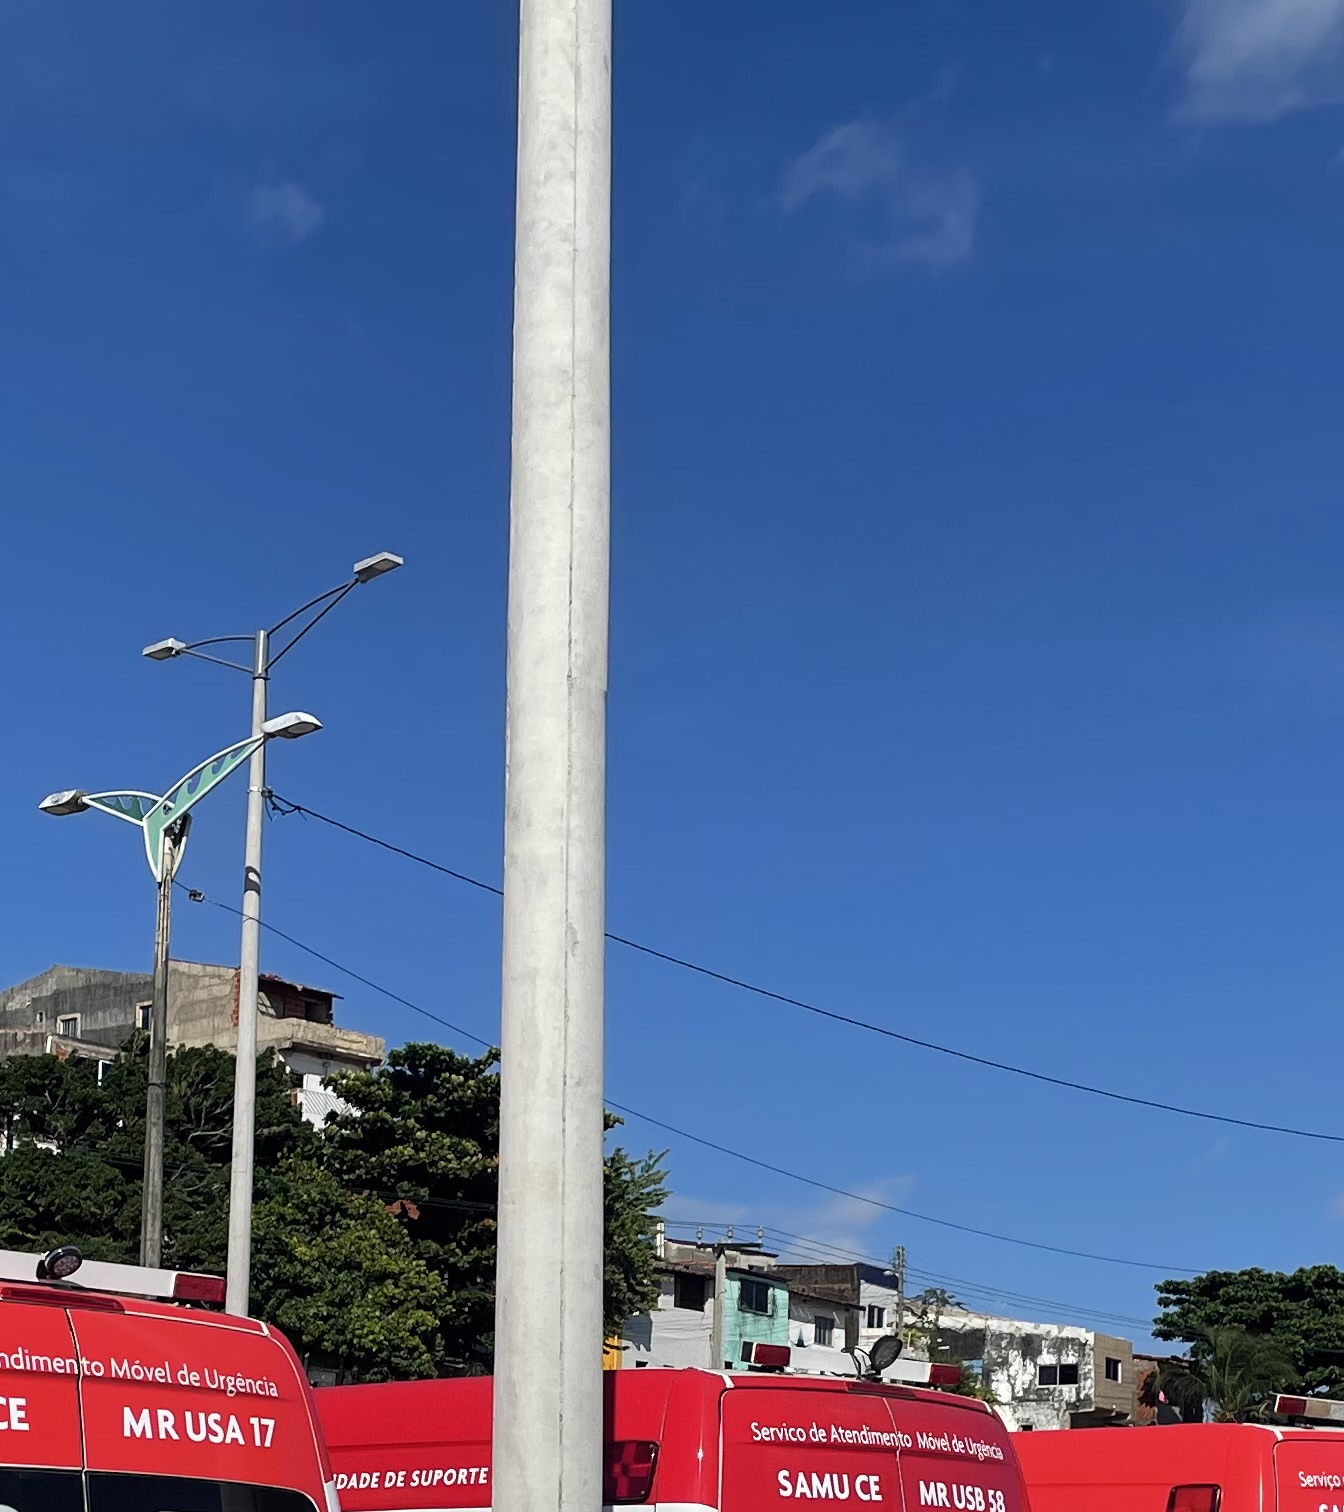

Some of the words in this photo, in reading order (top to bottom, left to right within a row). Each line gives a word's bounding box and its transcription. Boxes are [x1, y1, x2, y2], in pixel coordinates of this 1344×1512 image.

[110, 1356, 173, 1384] Móvel
[177, 1363, 201, 1387] de
[205, 1367, 279, 1398] Urgência
[123, 1406, 180, 1441] MR
[184, 1410, 246, 1446] USA
[250, 1416, 276, 1448] 17
[809, 1421, 828, 1443] de
[830, 1423, 912, 1448] Atendimento
[916, 1431, 950, 1452] Móvel
[952, 1434, 965, 1454] de
[964, 1436, 1005, 1462] Urgência
[333, 1471, 381, 1490] DADE
[384, 1471, 407, 1488] DE
[410, 1467, 489, 1487] SUPORTE
[777, 1469, 849, 1500] SAMU
[855, 1474, 883, 1501] CE
[1299, 1470, 1341, 1491] Serviço
[919, 1480, 951, 1509] MR
[953, 1484, 986, 1512] USB
